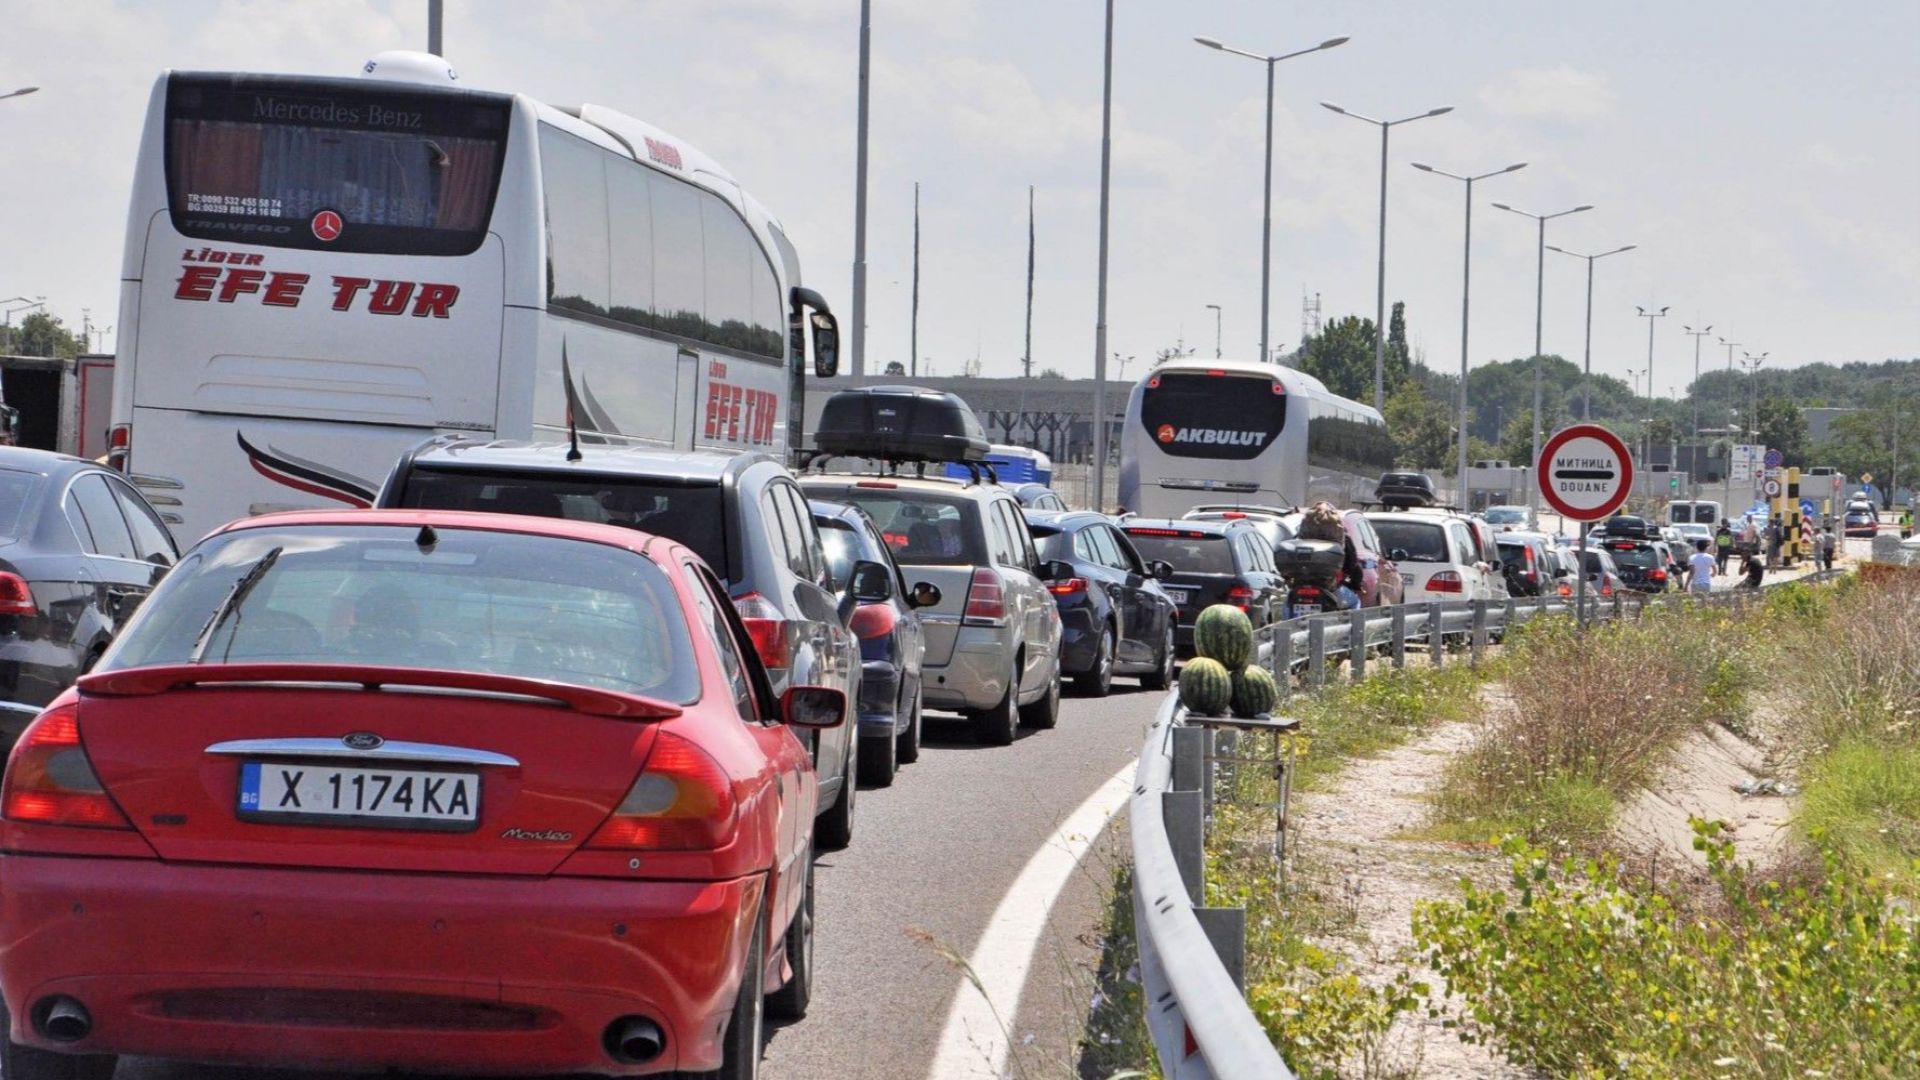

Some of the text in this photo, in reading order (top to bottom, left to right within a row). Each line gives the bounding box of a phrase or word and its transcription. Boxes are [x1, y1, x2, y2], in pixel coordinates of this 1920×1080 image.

[253, 97, 423, 128] Mercedes-Benz
[186, 220, 291, 233] TRAVEGO
[174, 265, 460, 318] EFE TUR
[704, 382, 777, 446] EFE TUR
[1175, 428, 1267, 446] AKBULUT
[1557, 458, 1613, 469] МИТНИЦА
[1560, 482, 1608, 492] DOUANE
[241, 792, 257, 804] BG
[279, 770, 304, 808] X
[502, 828, 572, 841] Mondeo
